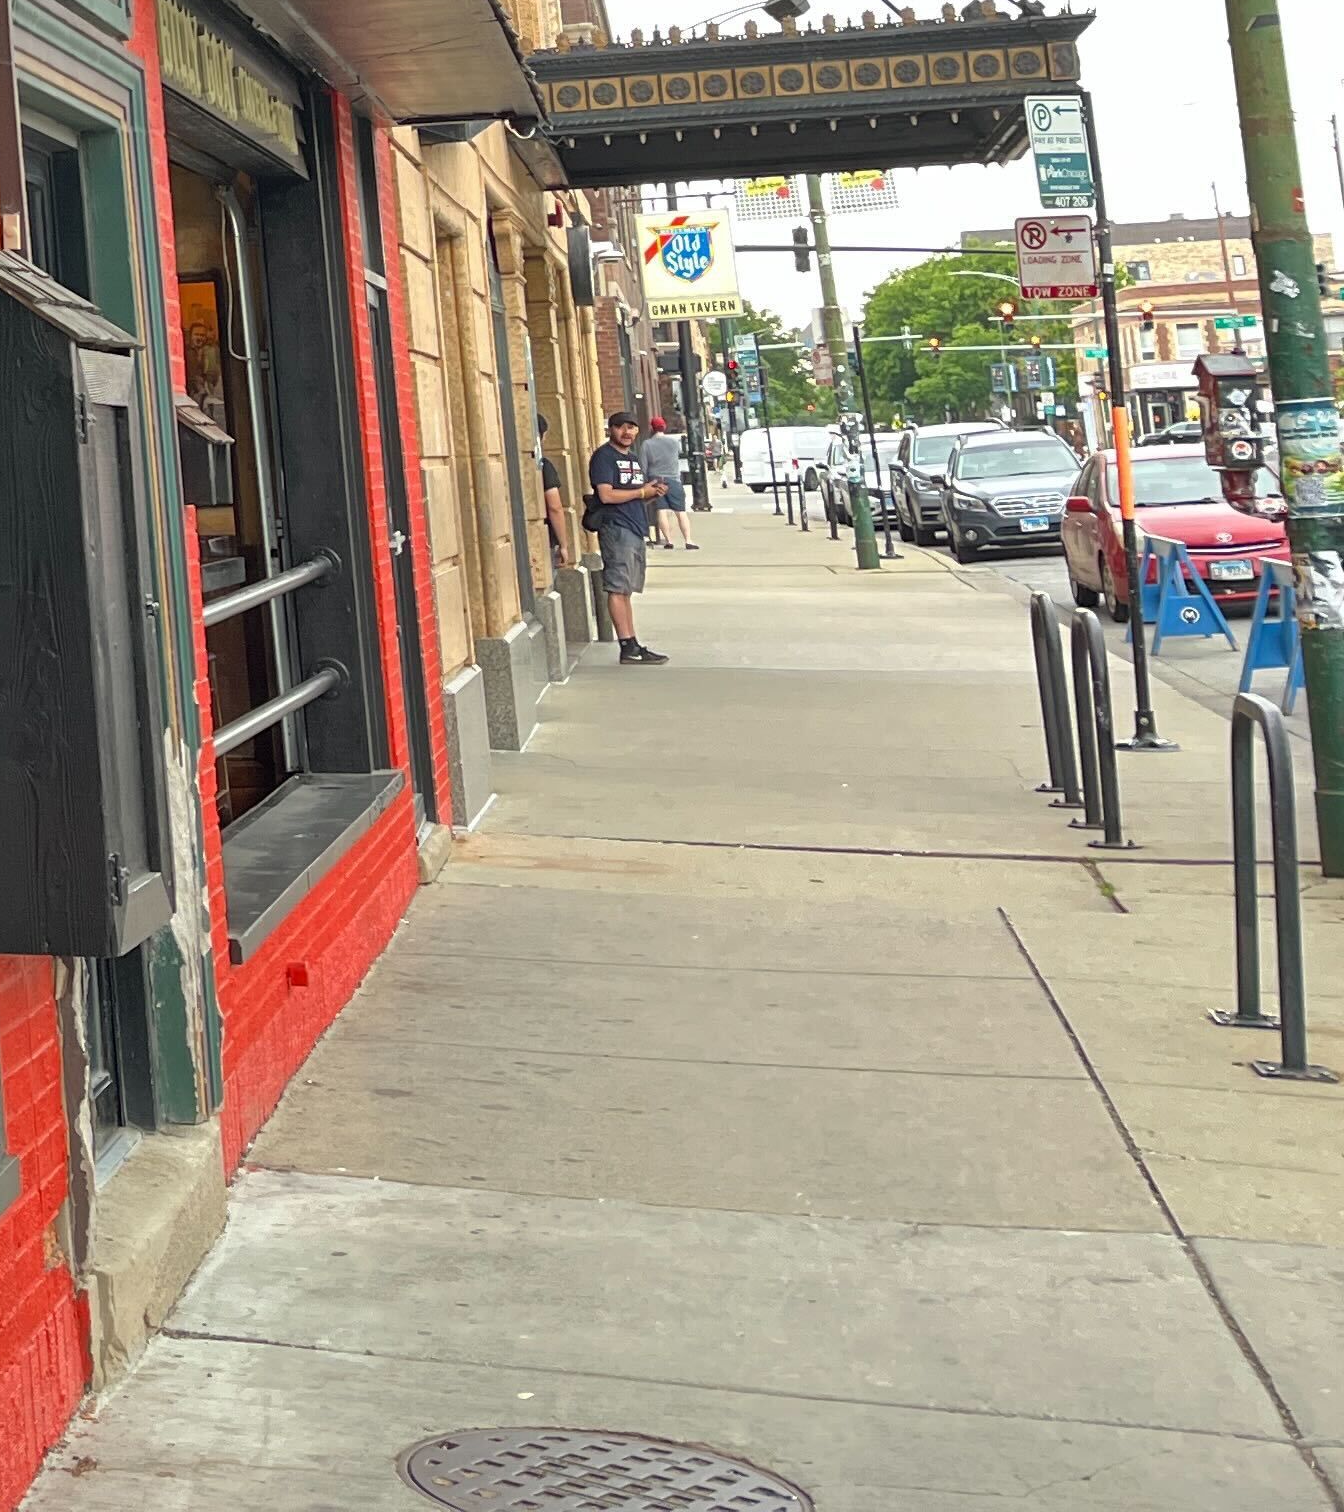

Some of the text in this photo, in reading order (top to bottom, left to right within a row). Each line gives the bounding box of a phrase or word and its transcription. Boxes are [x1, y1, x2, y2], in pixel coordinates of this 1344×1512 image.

[672, 234, 701, 255] Old
[666, 252, 709, 279] Style
[1023, 254, 1083, 265] LOADING ZONE
[1026, 286, 1091, 298] TOW ZONE
[652, 299, 736, 316] GMAN TAVERN
